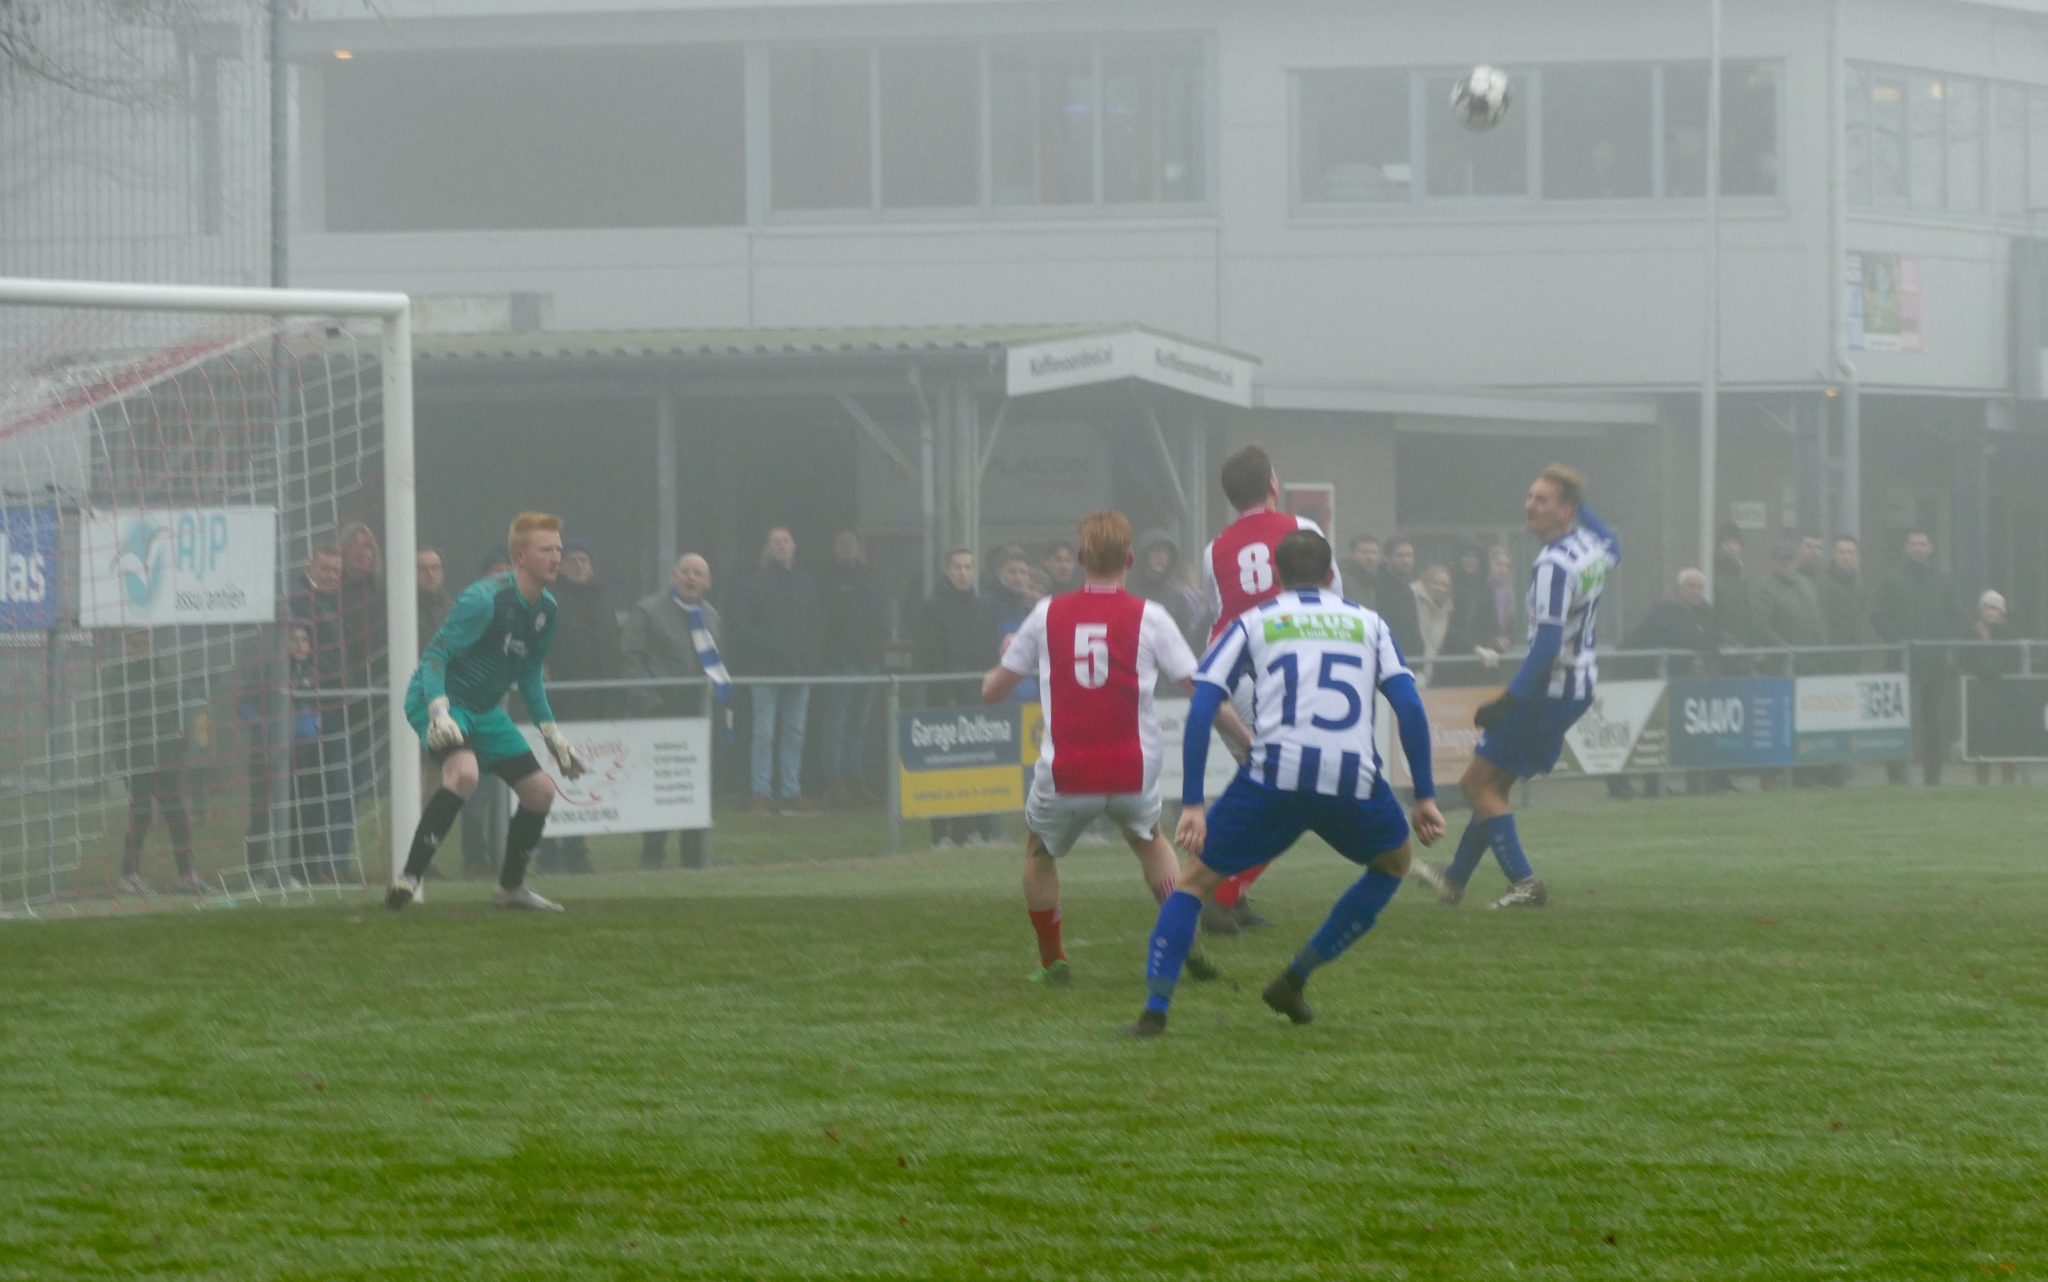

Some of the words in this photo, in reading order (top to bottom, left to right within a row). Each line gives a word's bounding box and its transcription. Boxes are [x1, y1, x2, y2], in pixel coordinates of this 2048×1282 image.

[1237, 542, 1273, 595] 8
[1292, 612, 1356, 631] PLUS
[1074, 623, 1109, 690] 5
[1267, 652, 1362, 731] 15
